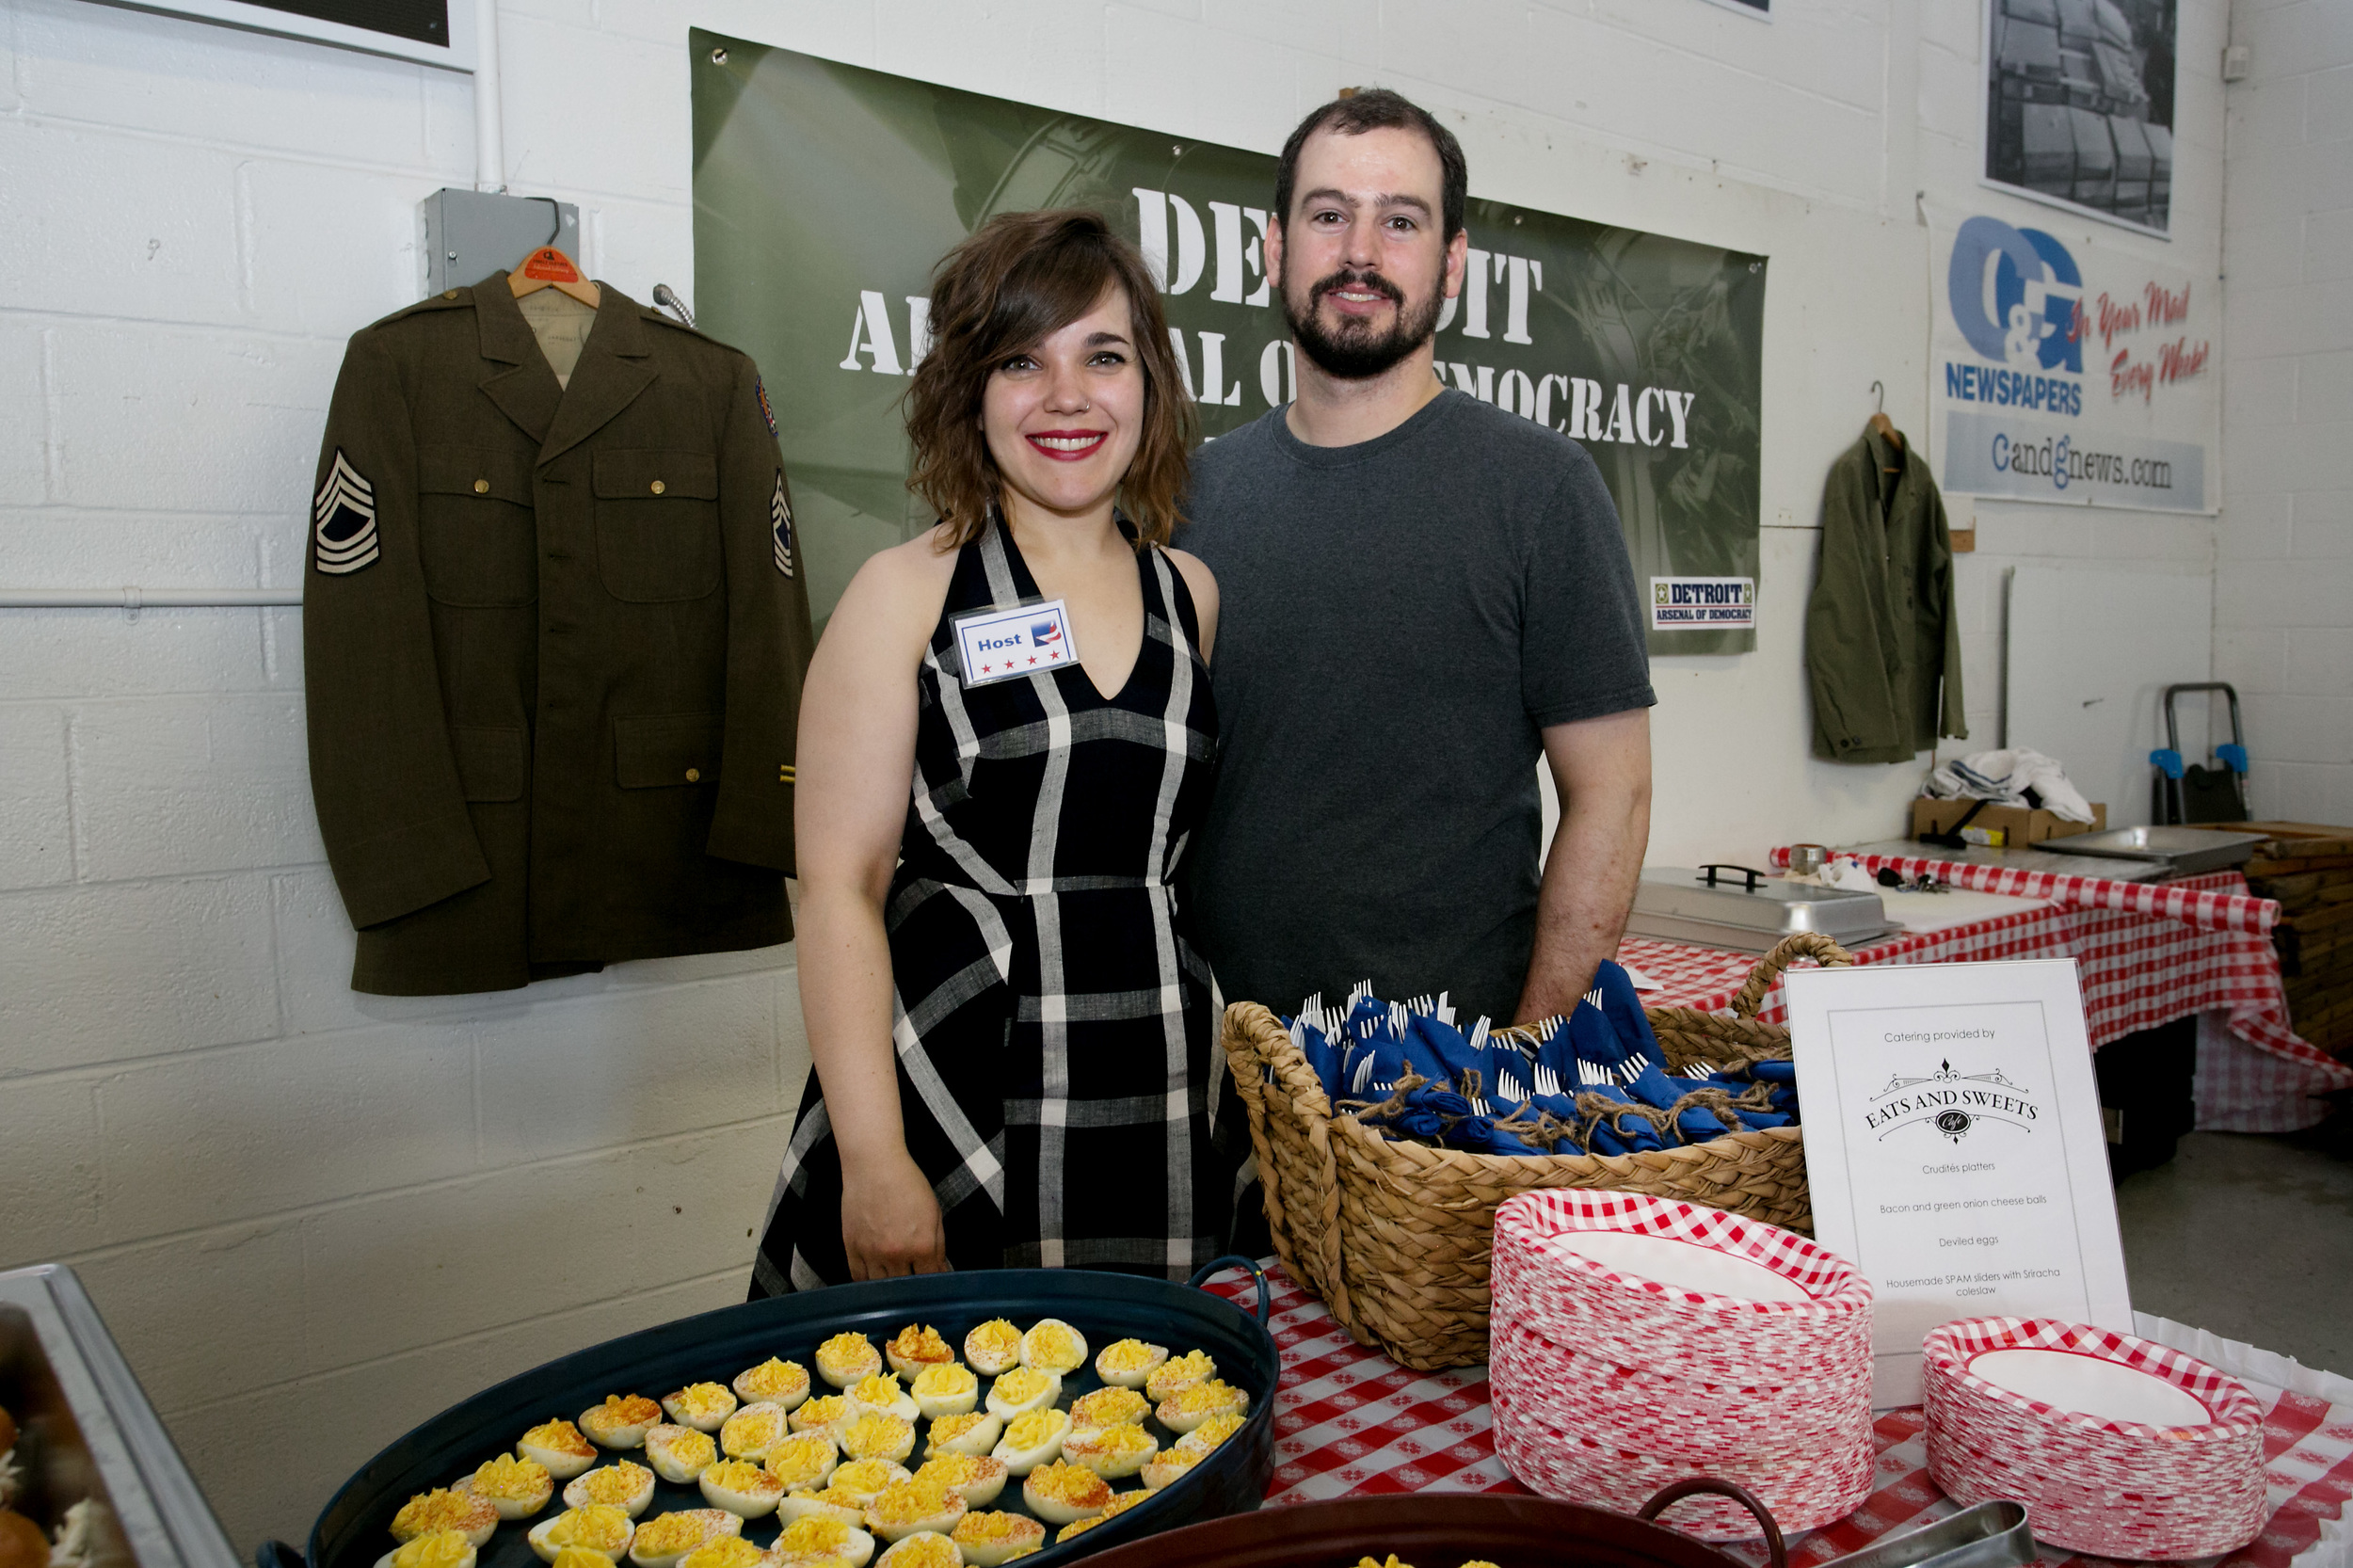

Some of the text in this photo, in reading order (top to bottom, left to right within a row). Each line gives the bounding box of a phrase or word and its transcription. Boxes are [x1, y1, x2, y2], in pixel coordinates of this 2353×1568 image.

[1132, 187, 1543, 344] DEIT
[2097, 291, 2141, 349] Your
[2144, 280, 2191, 326] Mail
[2110, 347, 2155, 405] Every
[1946, 362, 2082, 417] NEWSPAPERS
[1992, 433, 2172, 490] Candgnews.com
[1672, 584, 1742, 604] DETROIT
[1657, 608, 1753, 620] ARSENAL OF DEMOCRACY
[977, 633, 1022, 651] Host
[1884, 1028, 1995, 1043] Catering provided by
[1865, 1090, 2039, 1129] EATS AND SWEETS
[1922, 1161, 1995, 1175] Crudités platters
[1880, 1194, 2047, 1214] Bacon and green onion cheese balls
[1939, 1235, 1999, 1247] Deviled eggs
[1886, 1268, 2060, 1288] Housemade SPAM sliders with Sriracha
[1956, 1286, 1996, 1297] coleslaw
